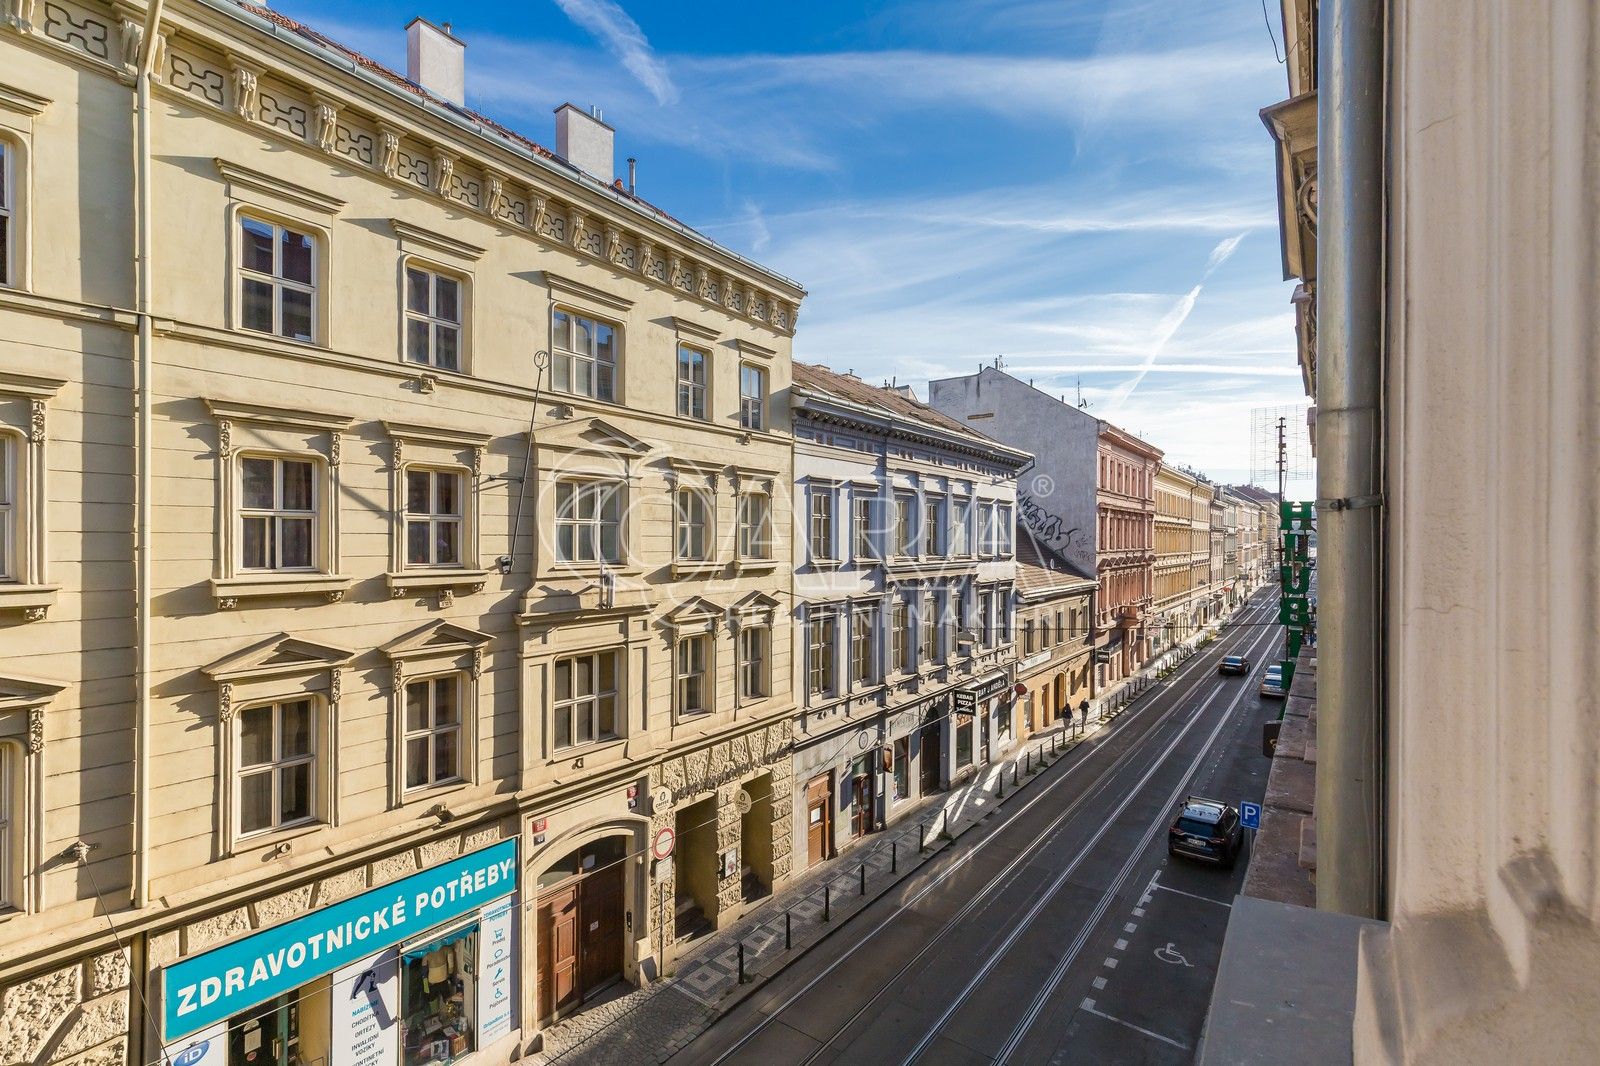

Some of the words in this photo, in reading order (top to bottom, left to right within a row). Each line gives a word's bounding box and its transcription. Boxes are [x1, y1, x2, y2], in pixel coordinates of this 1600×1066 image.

[956, 693, 974, 701] KEBAB
[1244, 806, 1257, 820] P
[177, 895, 406, 1017] ZDRAVOTNICKÉ
[415, 857, 512, 917] POTŘEBY
[185, 1048, 202, 1063] iD
